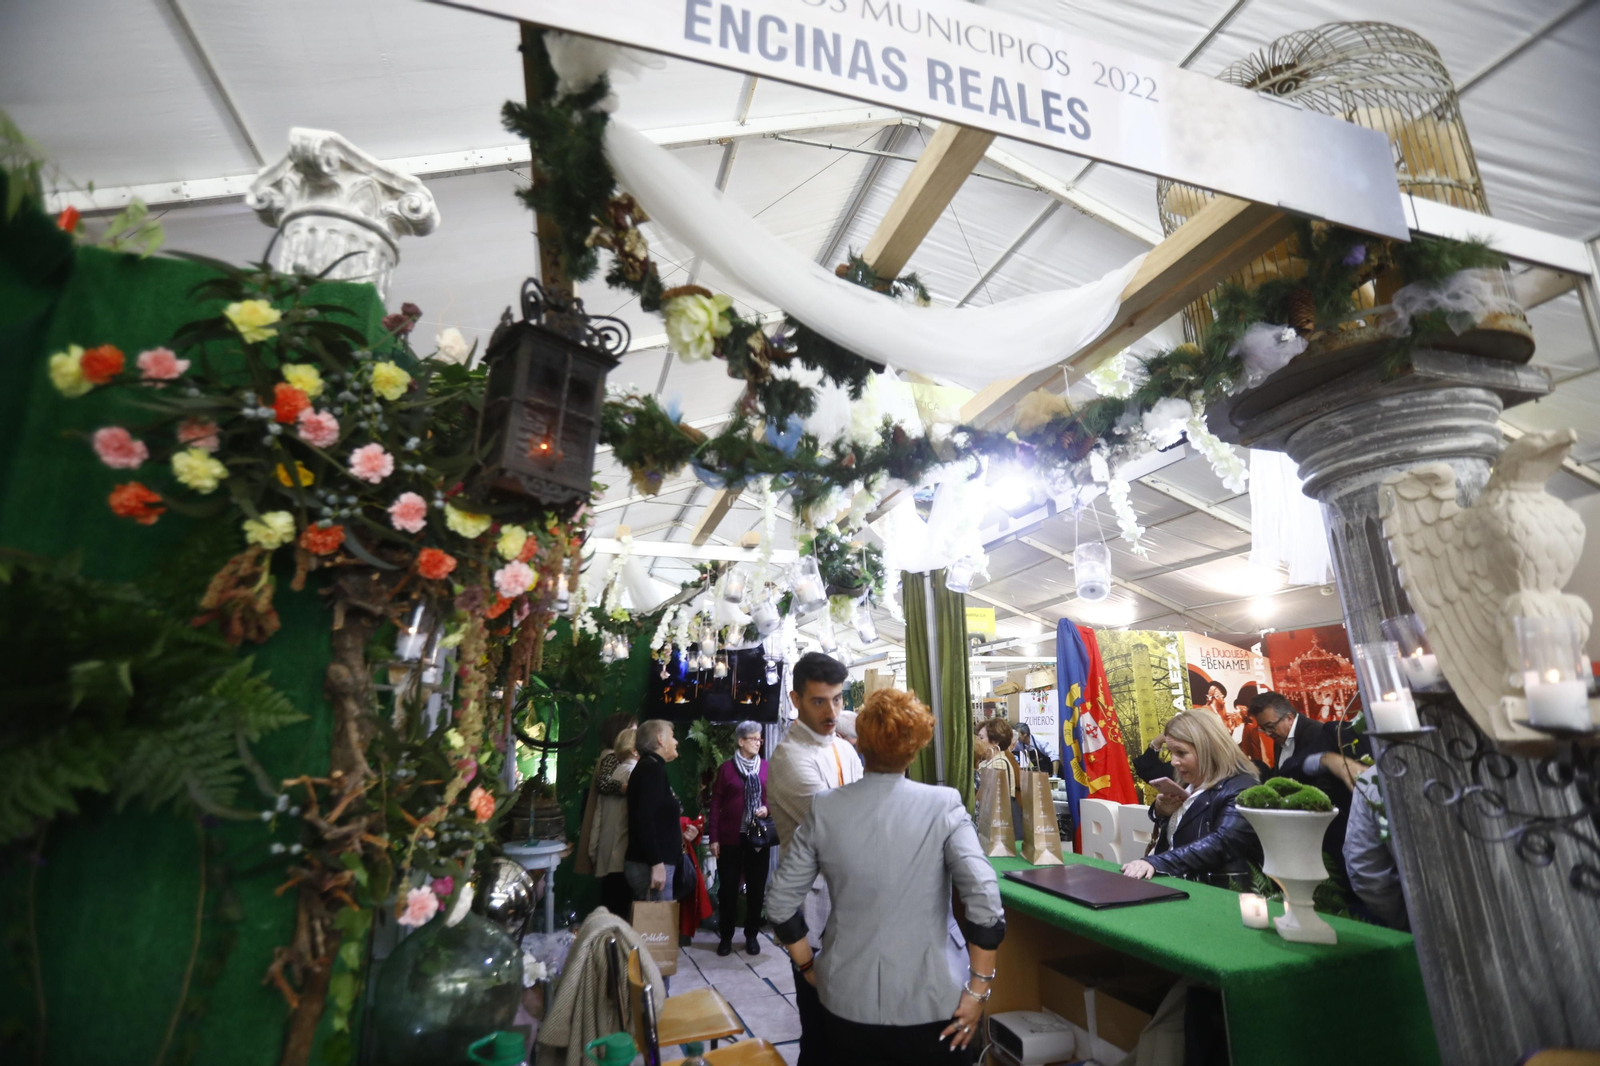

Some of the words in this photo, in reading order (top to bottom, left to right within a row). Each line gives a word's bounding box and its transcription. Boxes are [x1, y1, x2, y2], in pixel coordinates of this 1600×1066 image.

[684, 0, 908, 93] ENCINAS
[926, 57, 1092, 141] REALES
[861, 0, 1071, 77] MUNICIPIOS
[1092, 61, 1160, 103] 2022
[1200, 647, 1211, 658] LA
[1024, 715, 1055, 726] ZUHEROS
